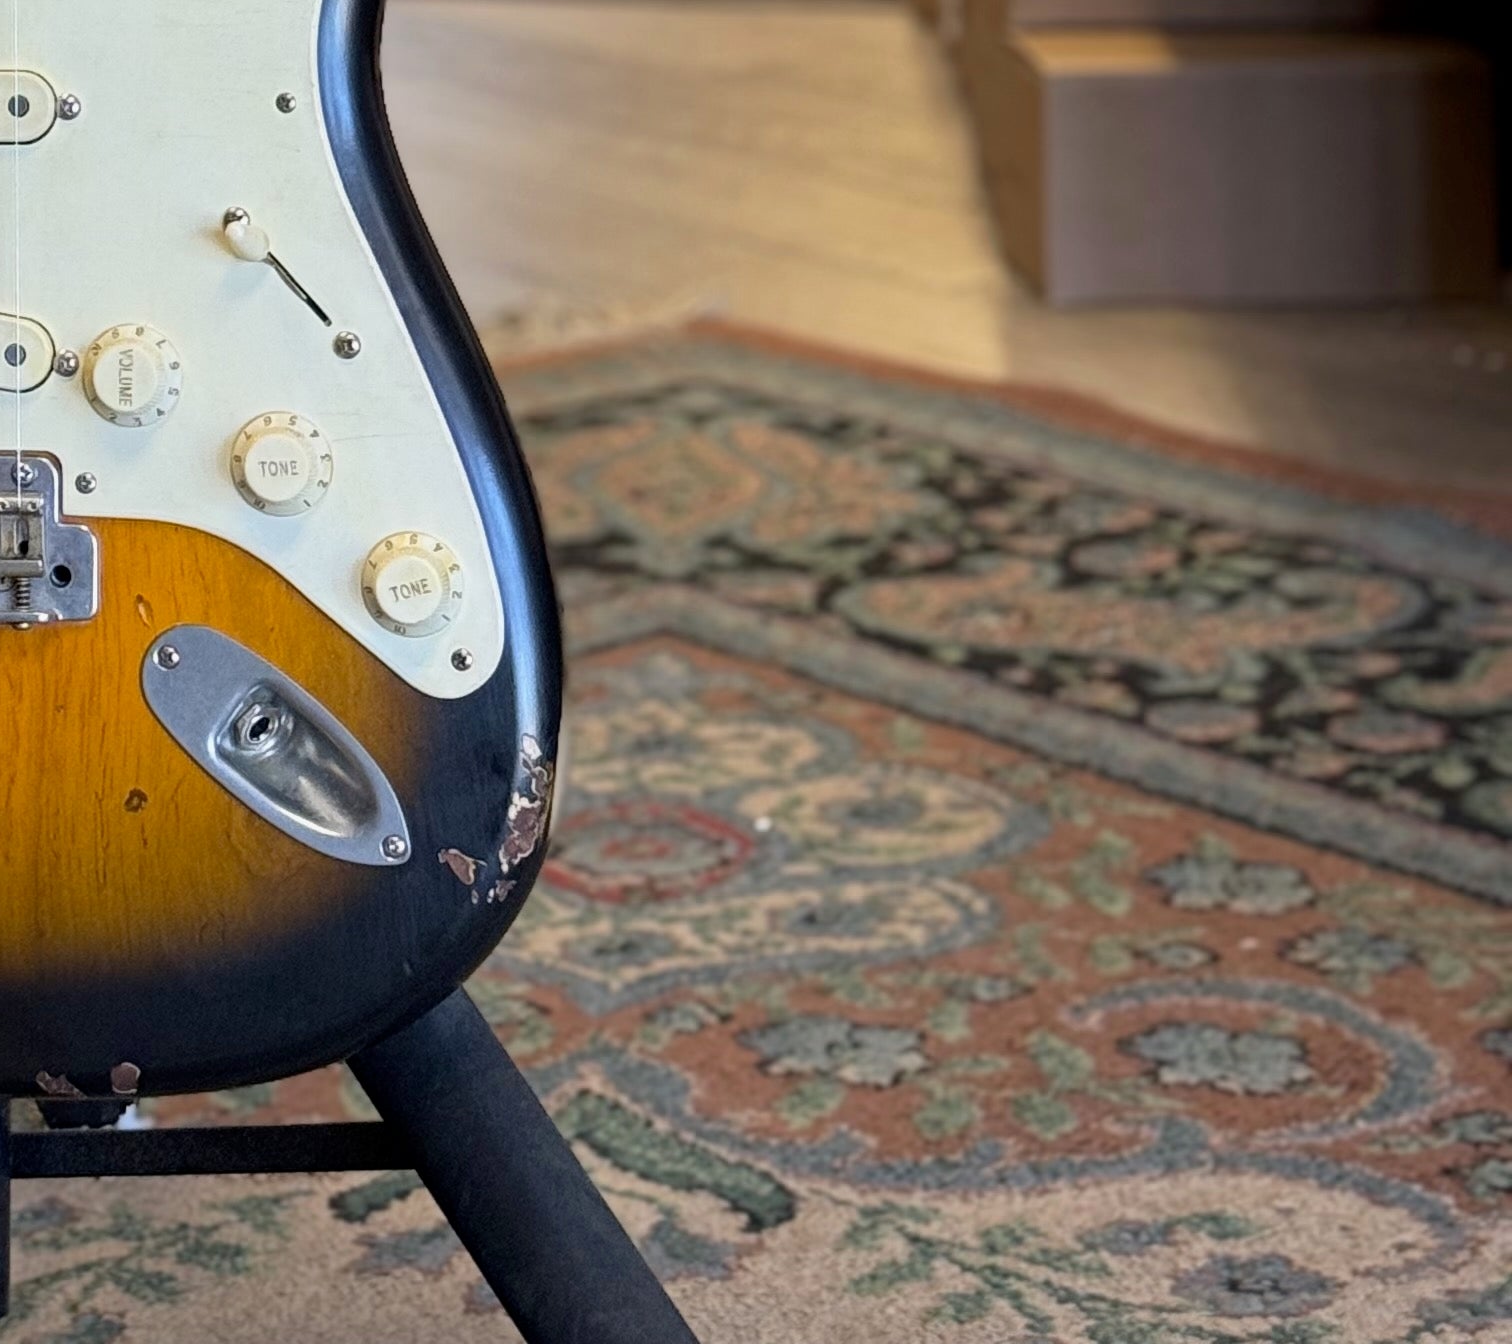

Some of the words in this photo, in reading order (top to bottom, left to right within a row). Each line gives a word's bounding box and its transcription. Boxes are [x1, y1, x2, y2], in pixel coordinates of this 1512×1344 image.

[118, 348, 134, 407] VOLUME
[257, 460, 300, 477] TONE
[388, 578, 433, 603] TONE
